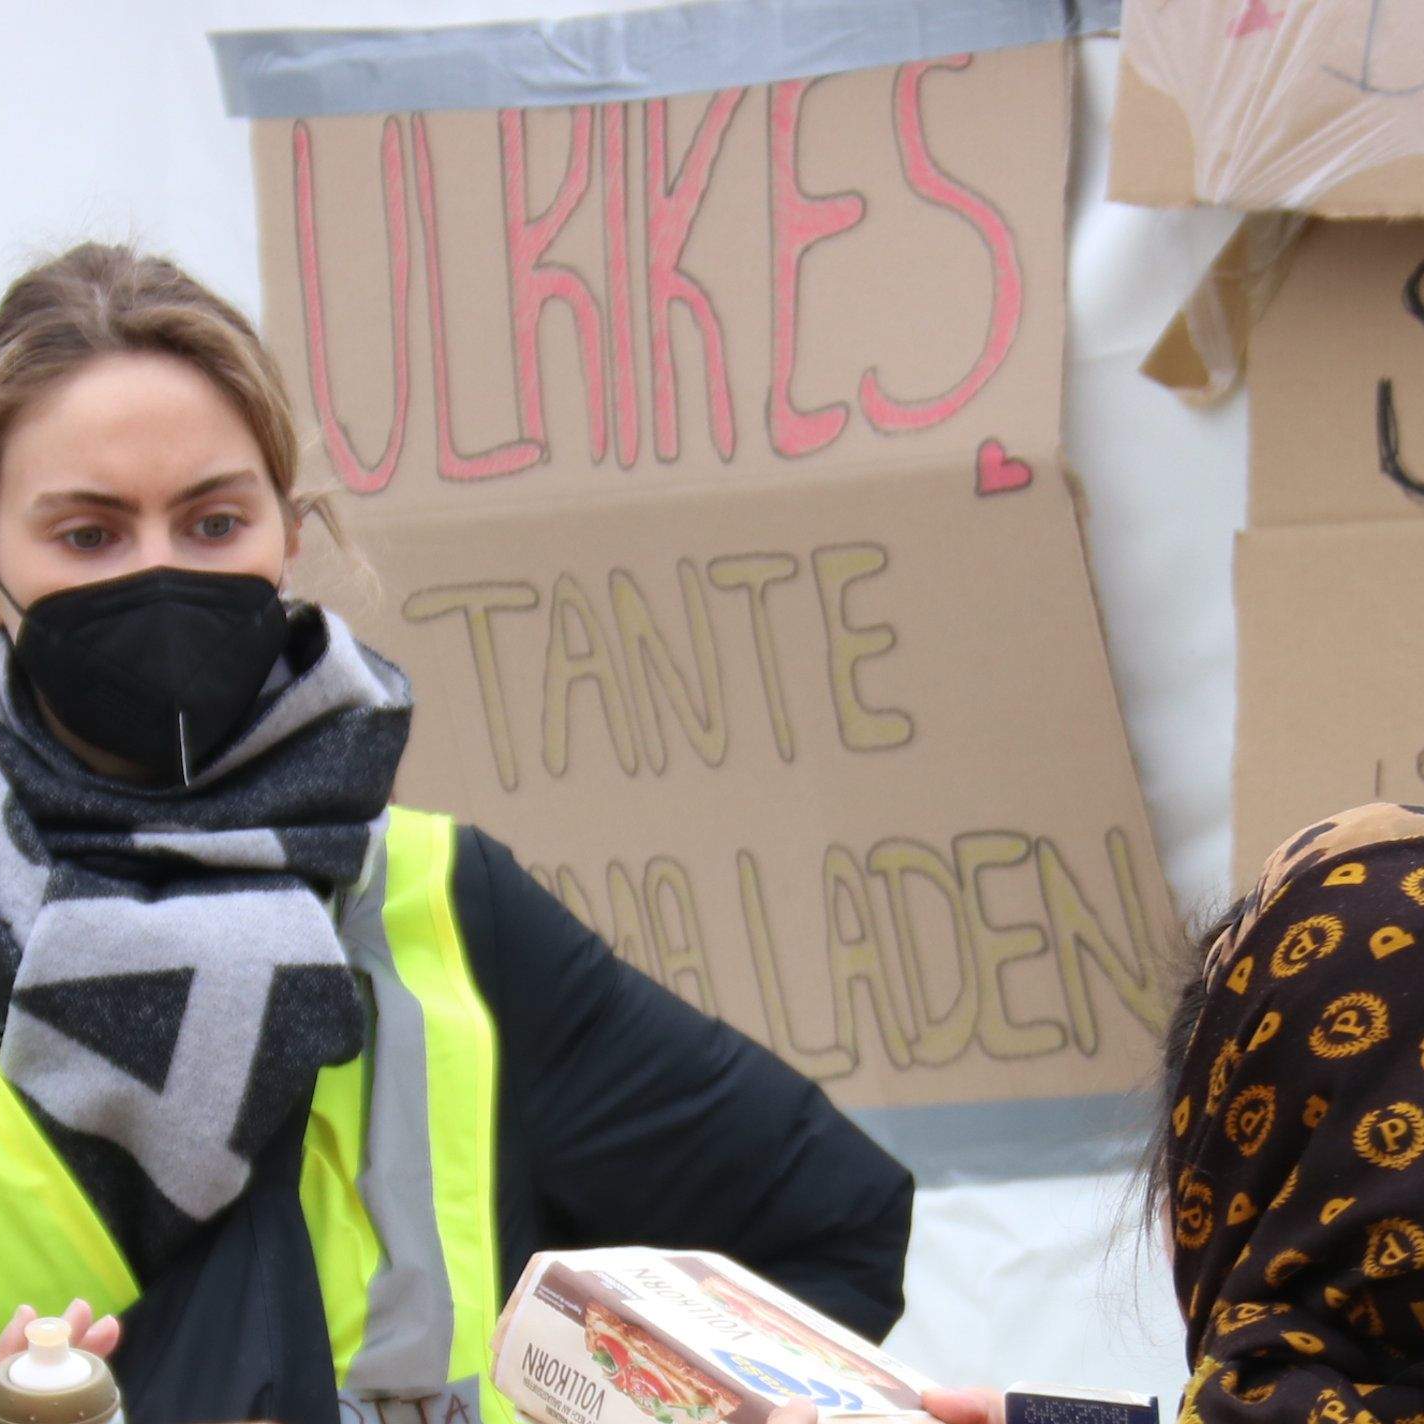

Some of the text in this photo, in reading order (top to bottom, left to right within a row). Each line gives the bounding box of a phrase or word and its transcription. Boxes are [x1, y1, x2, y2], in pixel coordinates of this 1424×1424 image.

[293, 52, 1023, 496] ULRIKES
[402, 542, 915, 792] TANTE
[736, 826, 1173, 1082] LADEN
[521, 1342, 605, 1420] VOLLKORN
